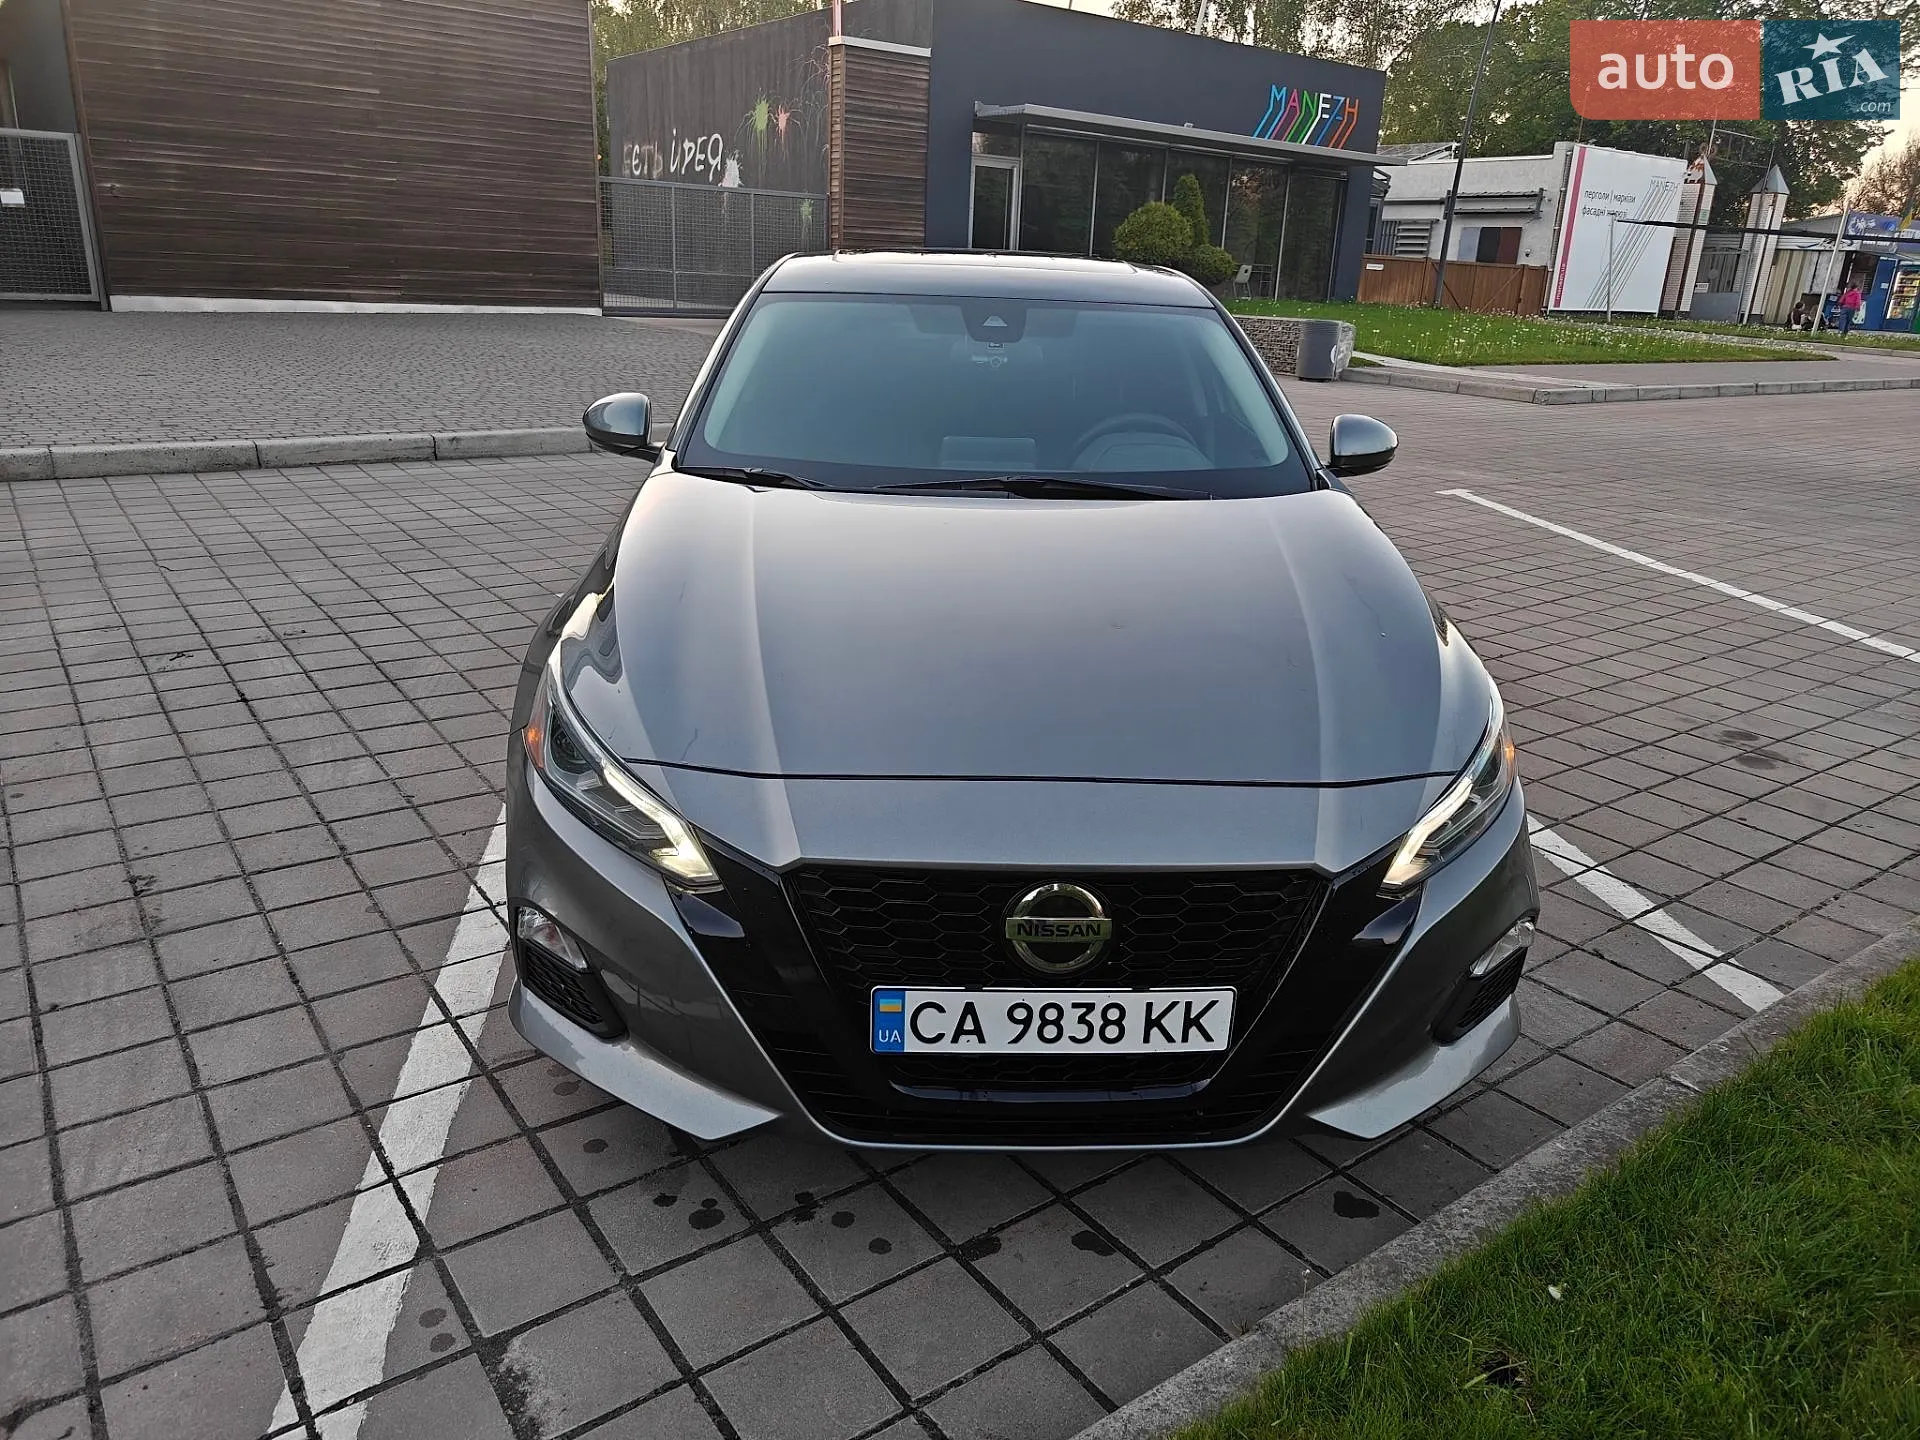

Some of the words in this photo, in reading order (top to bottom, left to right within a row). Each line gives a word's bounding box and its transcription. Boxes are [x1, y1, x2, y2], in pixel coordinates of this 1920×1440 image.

[1252, 84, 1359, 148] MANEZH
[1017, 923, 1101, 937] NISSAN
[878, 1029, 902, 1044] UA
[909, 1001, 987, 1045] CA
[1006, 1001, 1127, 1045] 9838
[1142, 999, 1219, 1044] KK
